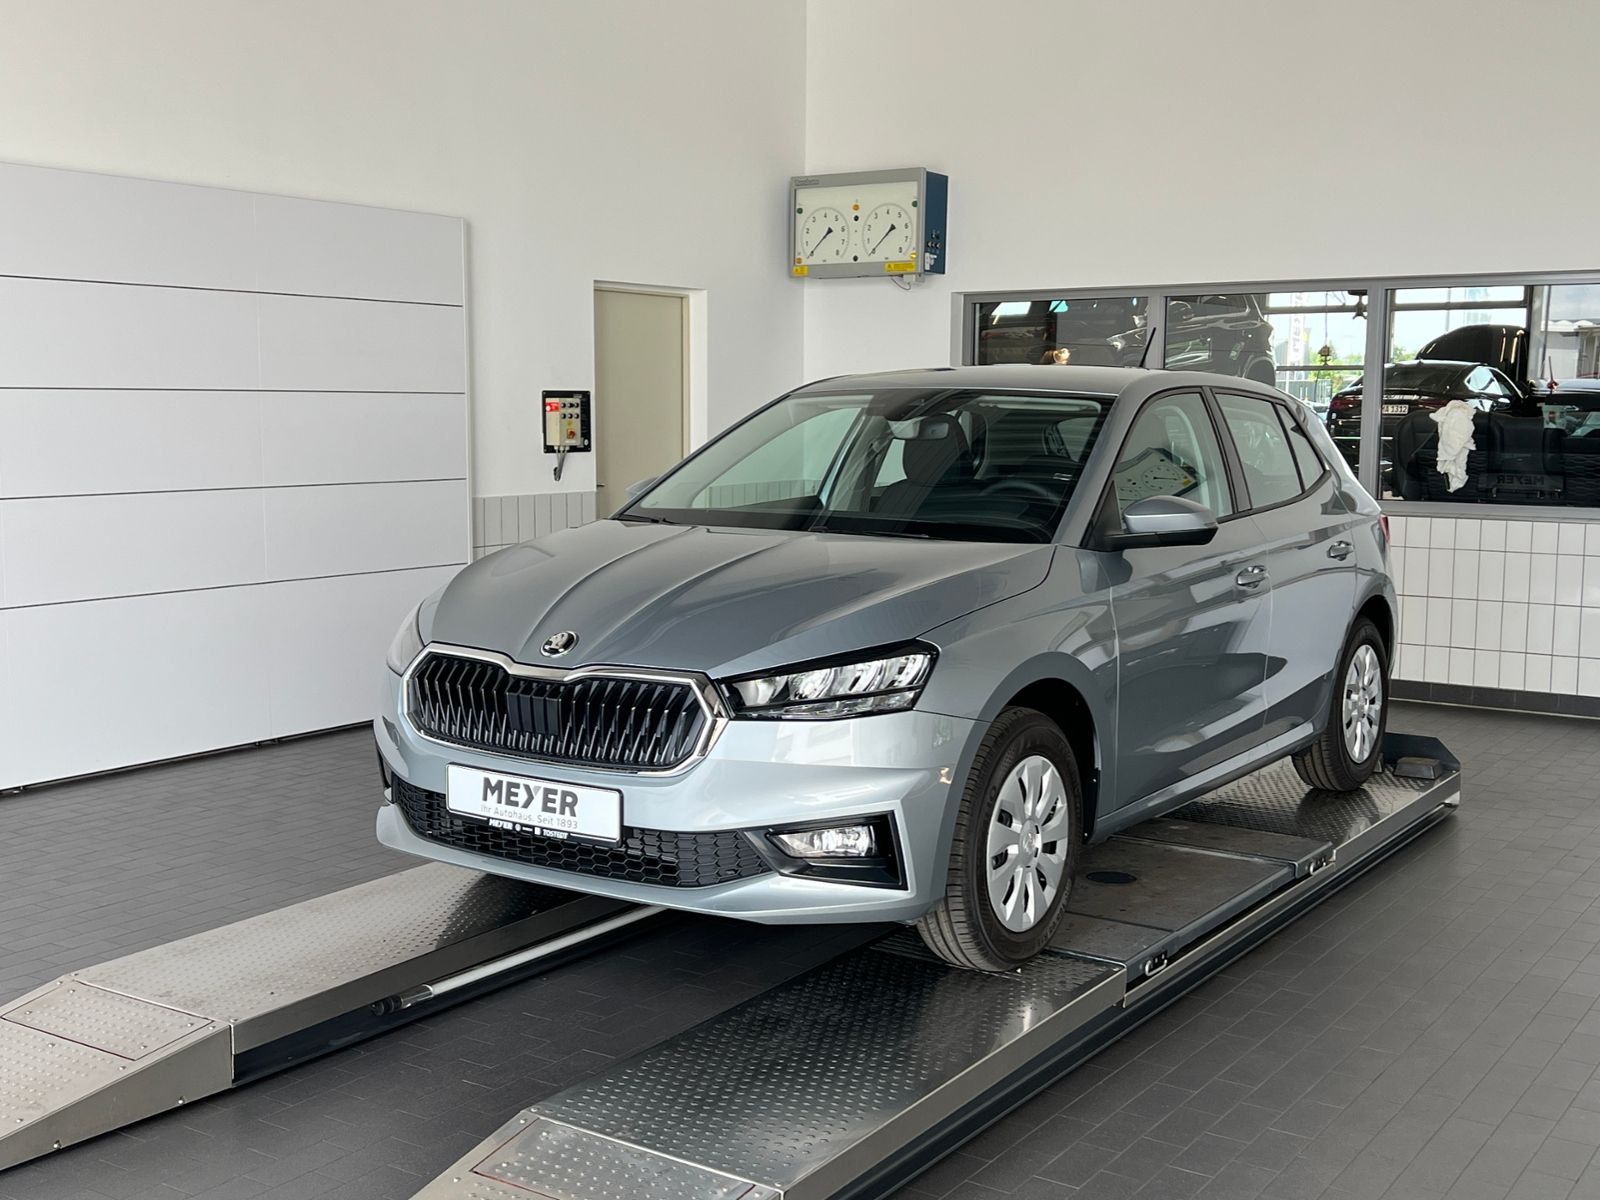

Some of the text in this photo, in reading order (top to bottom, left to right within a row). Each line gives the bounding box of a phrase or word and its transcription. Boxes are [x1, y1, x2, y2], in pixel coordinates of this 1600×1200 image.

[481, 777, 579, 818] MEYER
[488, 818, 514, 830] MEYER
[493, 806, 535, 821] Autohaus.
[537, 814, 554, 825] Seit
[556, 818, 578, 829] 1893
